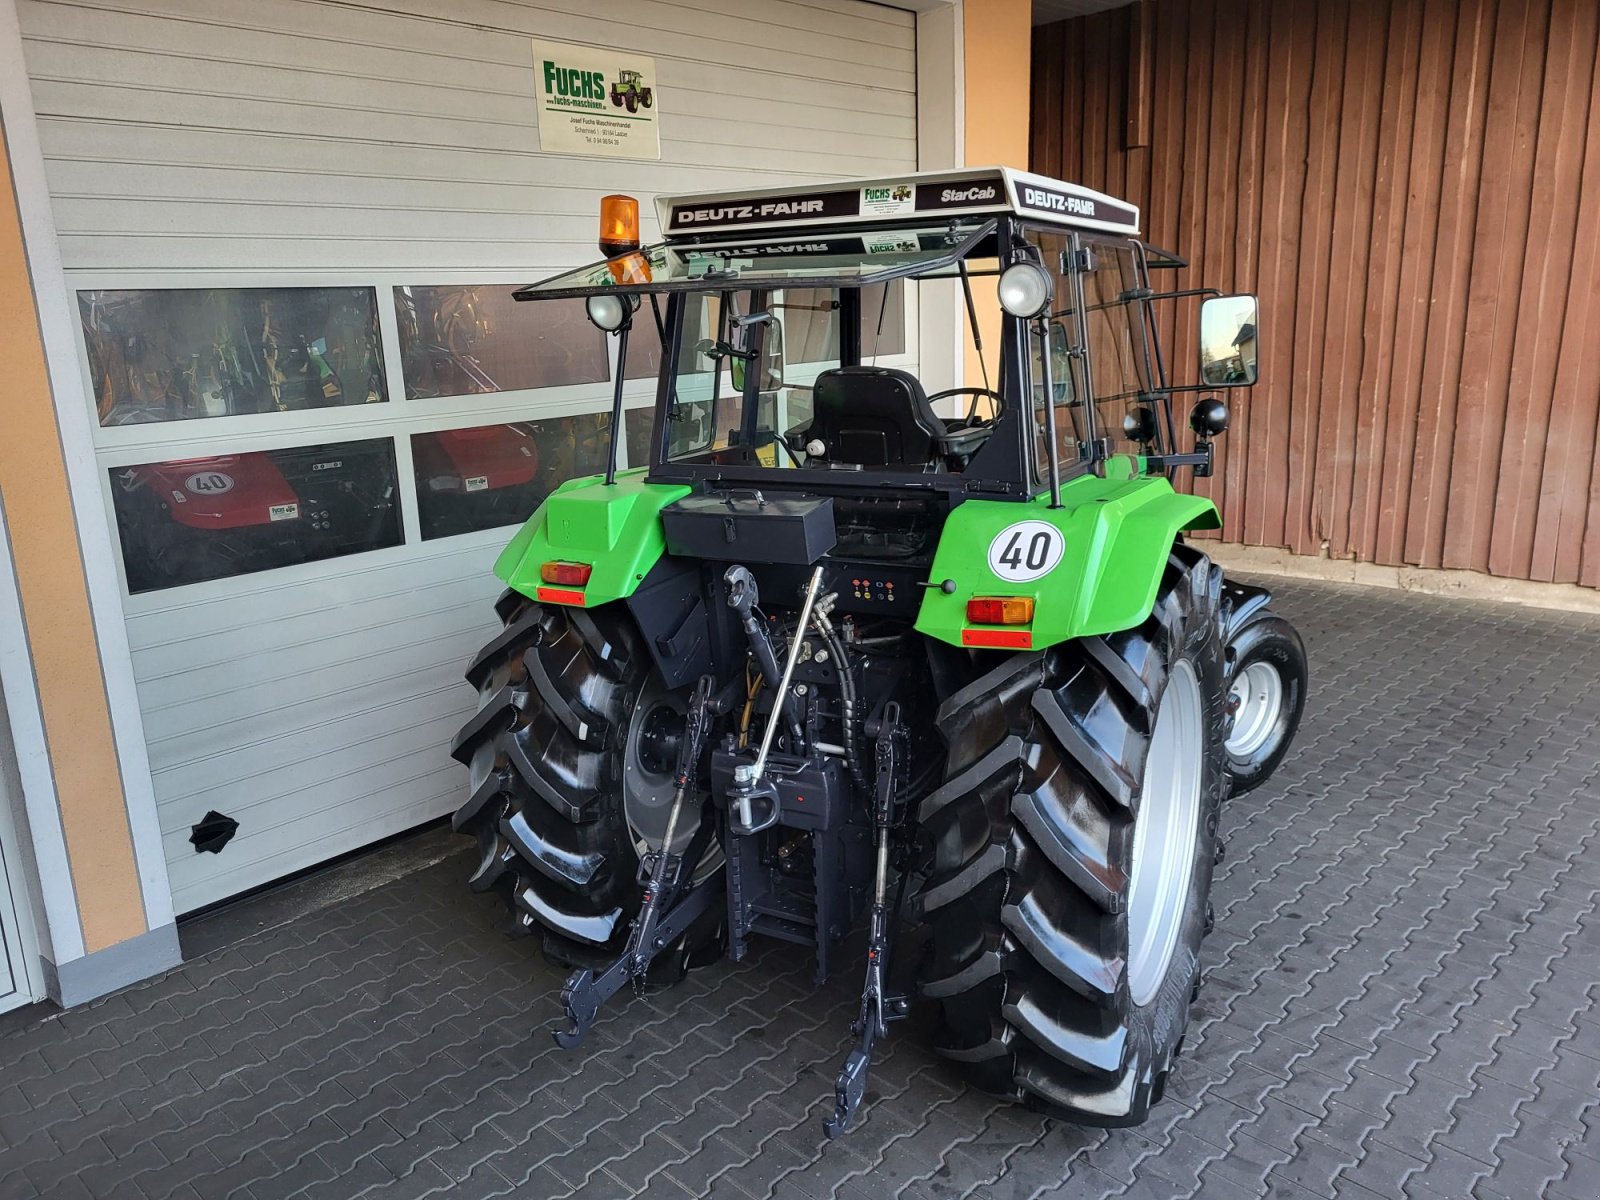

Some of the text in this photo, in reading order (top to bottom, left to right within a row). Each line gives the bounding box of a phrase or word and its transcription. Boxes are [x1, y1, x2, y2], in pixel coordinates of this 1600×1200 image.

[543, 60, 605, 100] FUCHS
[865, 188, 890, 200] FUCHS
[941, 186, 996, 202] StarCab
[1024, 188, 1095, 216] DEUTZ-FAHR
[678, 200, 824, 223] DEUTZ-FAHR
[195, 474, 227, 491] 40
[998, 531, 1052, 571] 40
